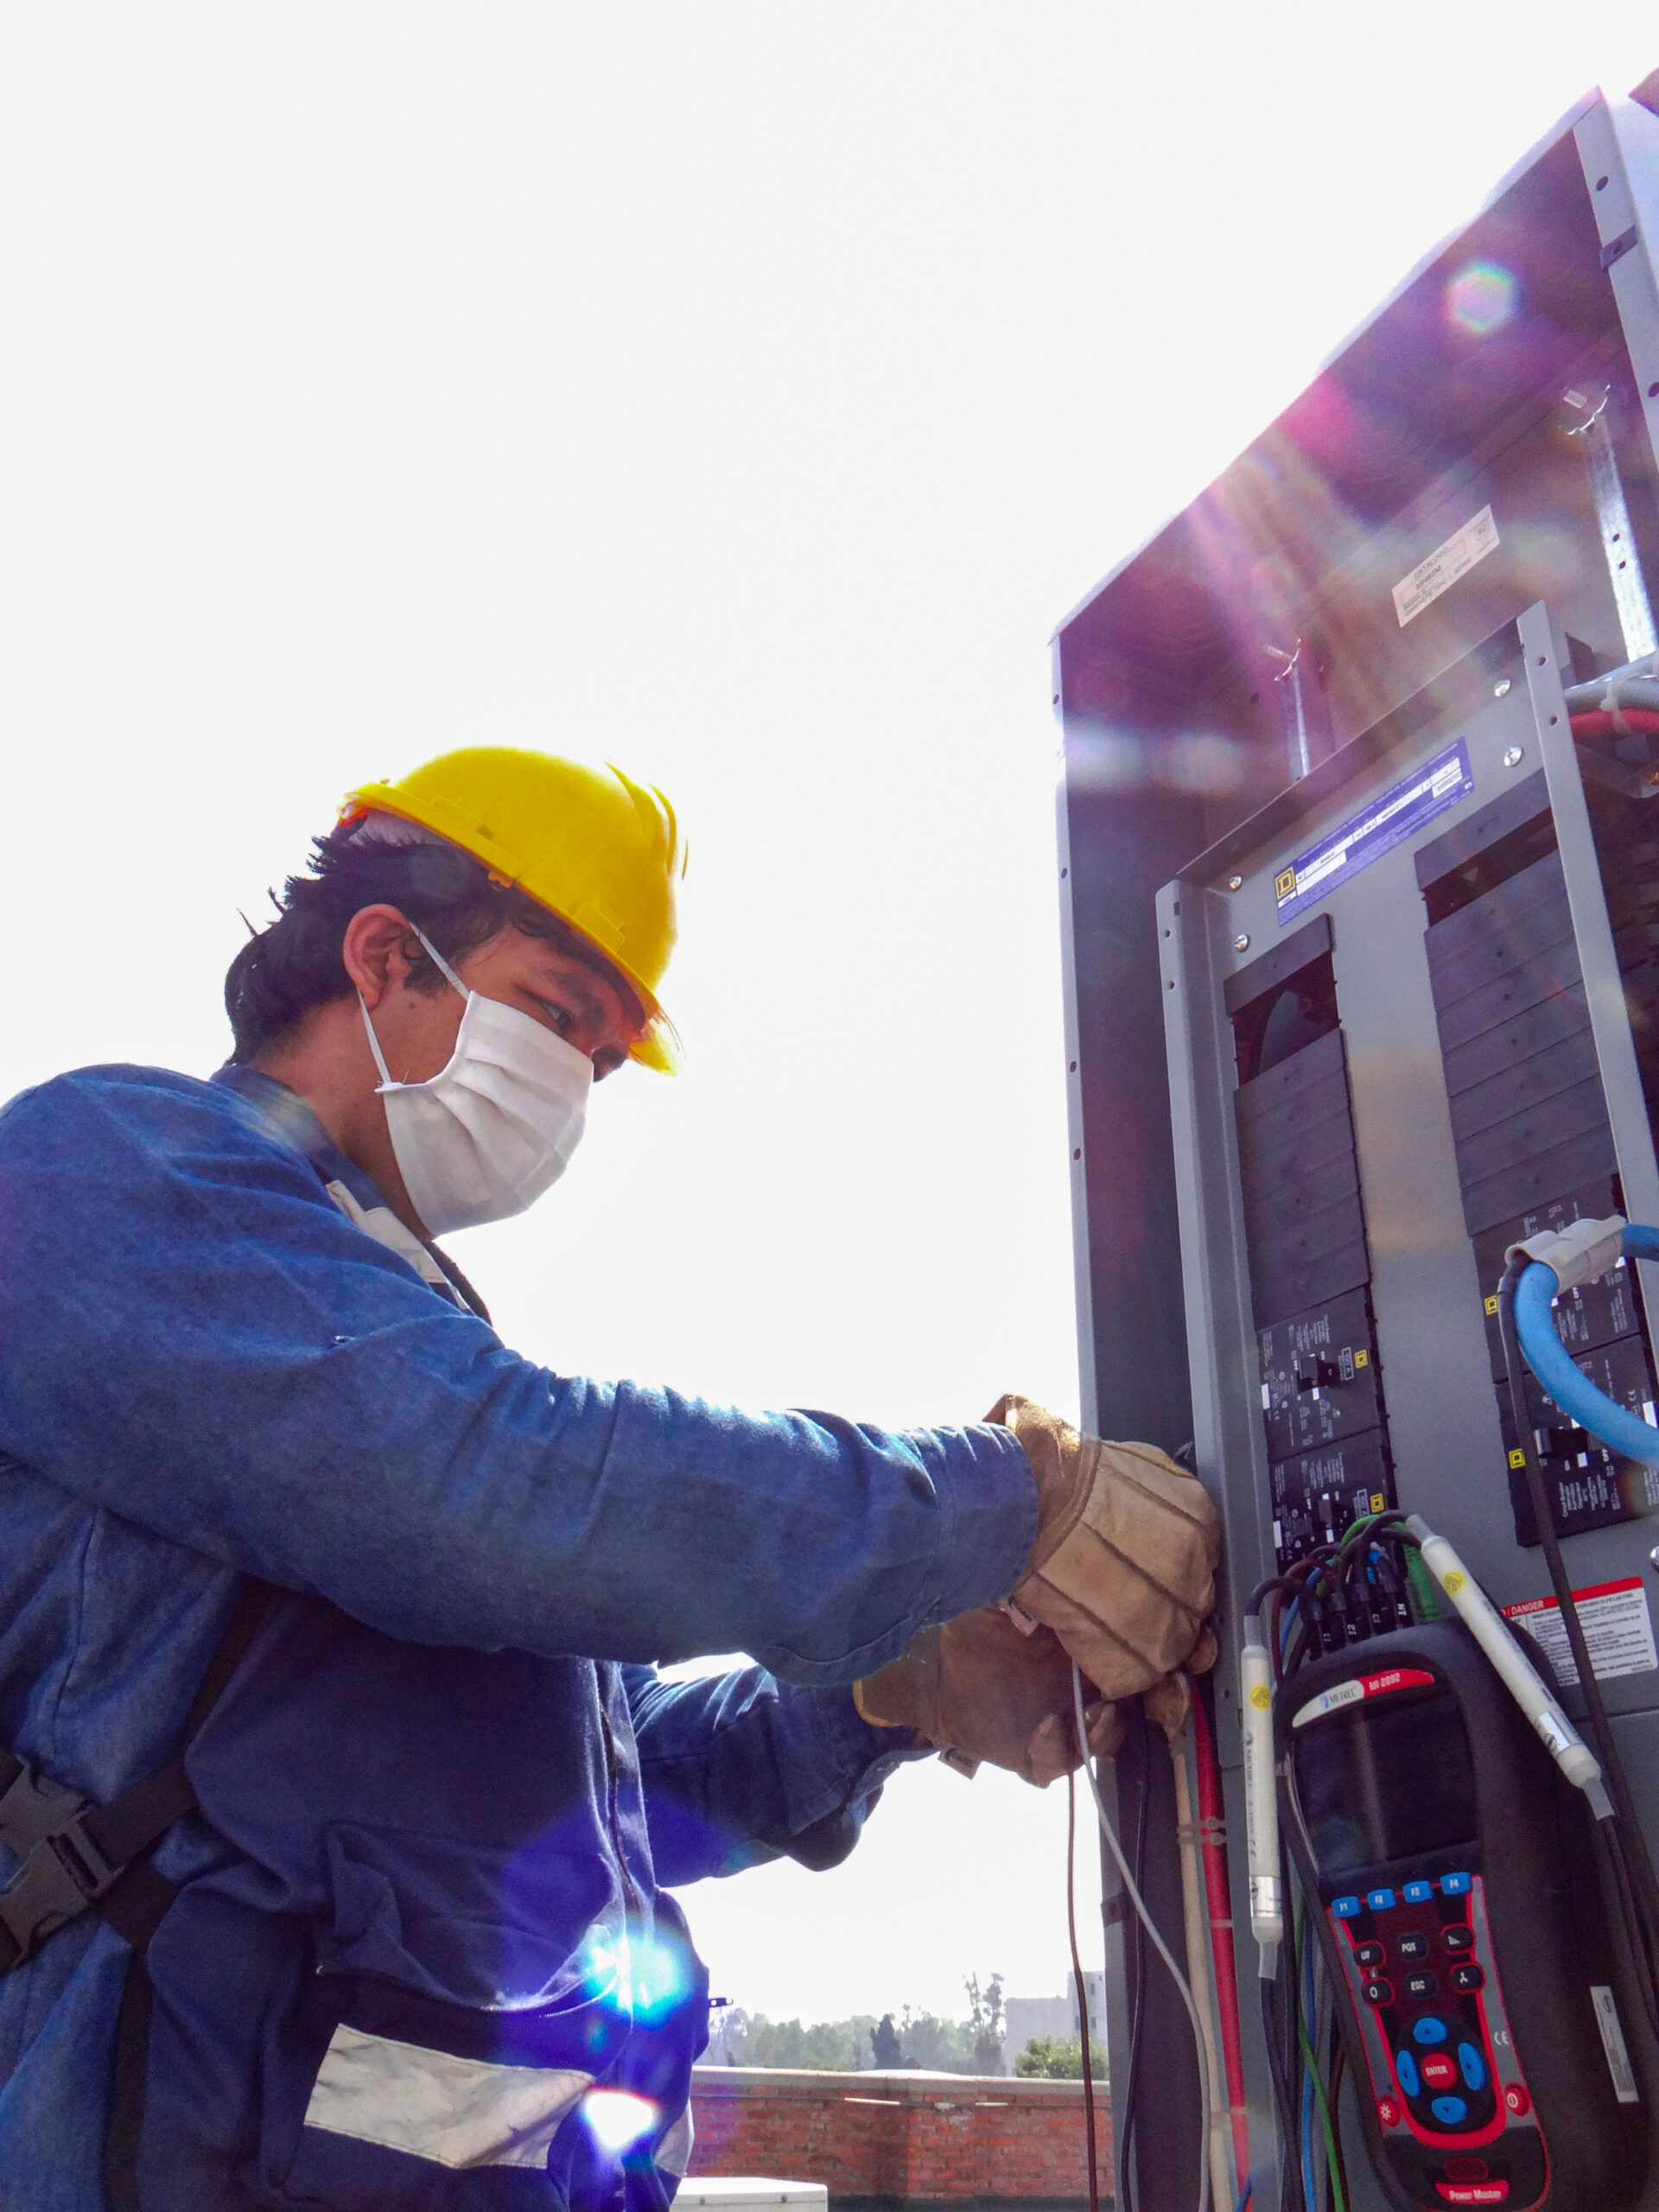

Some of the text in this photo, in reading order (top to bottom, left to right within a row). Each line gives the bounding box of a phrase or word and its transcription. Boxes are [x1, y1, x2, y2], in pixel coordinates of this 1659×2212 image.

[1511, 1600, 1544, 1615] DANGER
[1369, 1680, 1380, 1691] MI
[1449, 1878, 1459, 1888] F4
[1340, 1903, 1348, 1911] F1
[1402, 1942, 1416, 1953] PQS
[1410, 1980, 1426, 1991] ESC
[1494, 2031, 1510, 2045] CE
[1426, 2065, 1448, 2076] ENTER
[1449, 2189, 1502, 2200] Power Master
